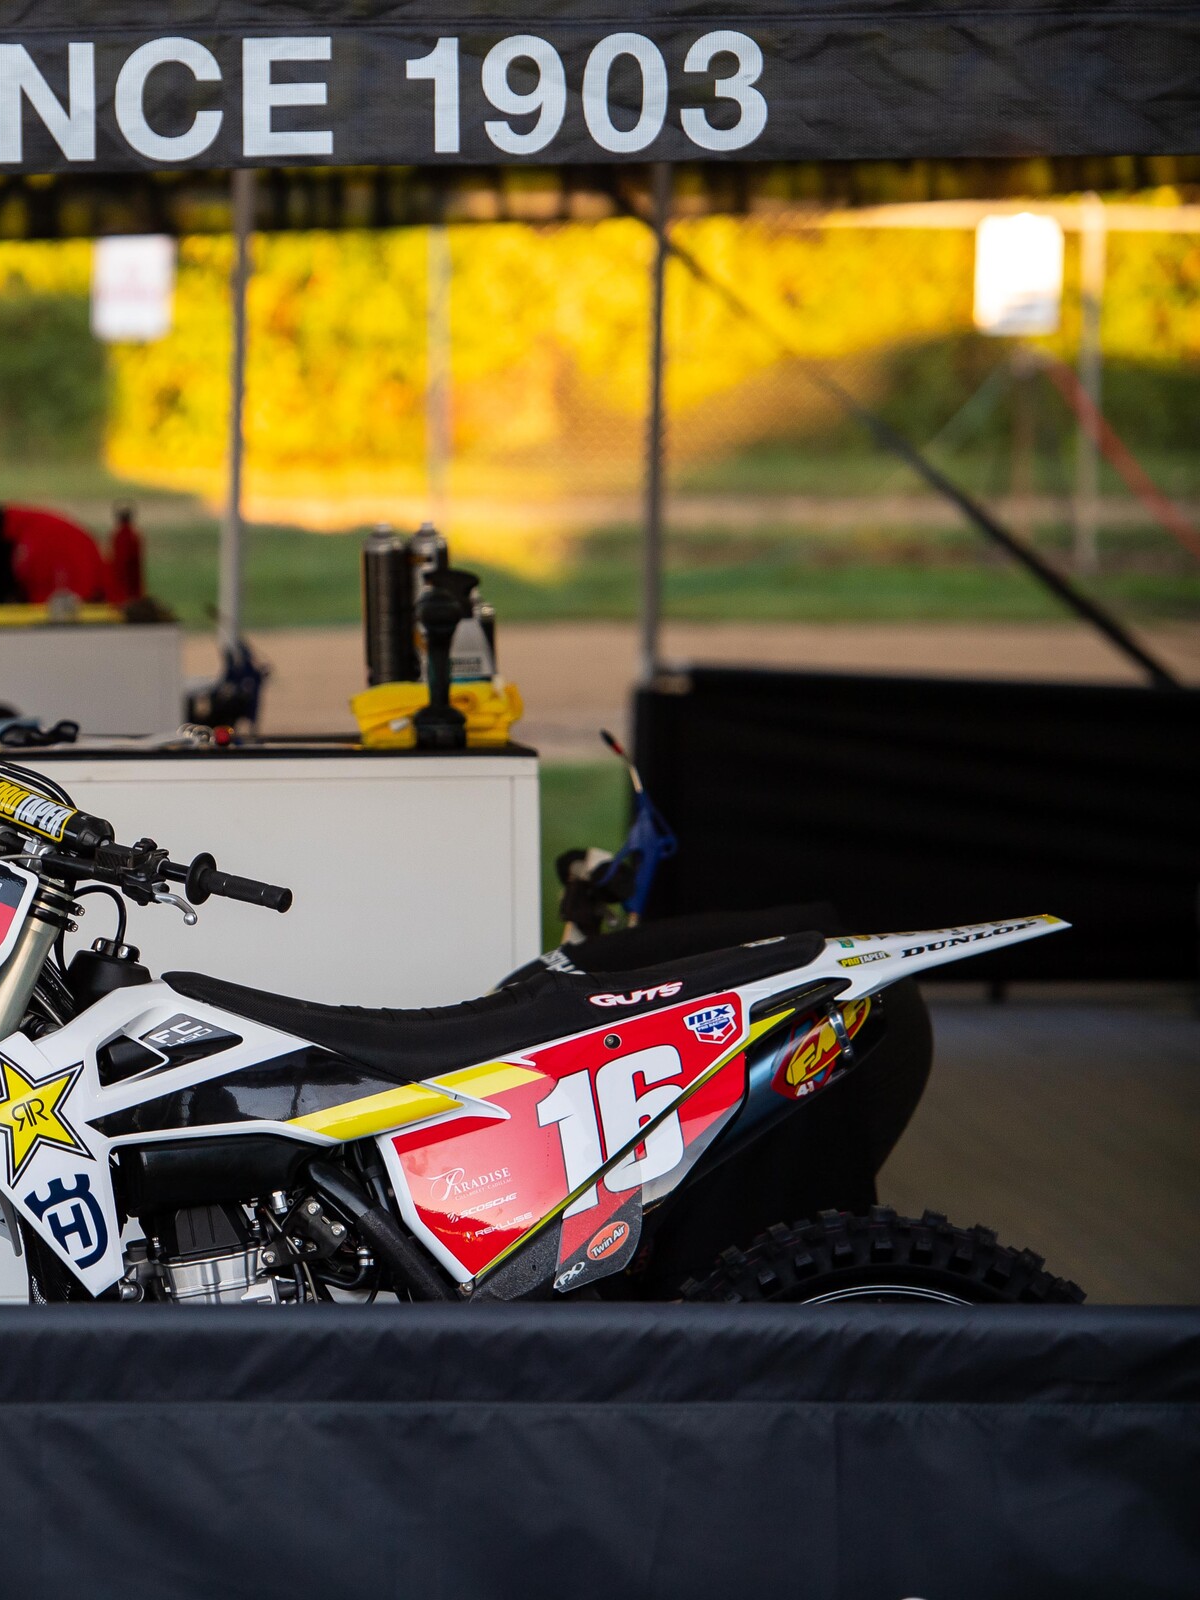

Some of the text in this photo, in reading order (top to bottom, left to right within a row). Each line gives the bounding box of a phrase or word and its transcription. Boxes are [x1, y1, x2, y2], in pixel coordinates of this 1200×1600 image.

[405, 30, 769, 155] 1903
[901, 921, 1037, 958] DUNLOP
[589, 981, 684, 1007] GUTS
[536, 1044, 685, 1220] 16
[427, 1167, 511, 1201] PARADISE
[460, 1192, 518, 1219] SCOSCHE
[475, 1211, 533, 1237] REKLUSE
[591, 1223, 626, 1258] Twin Air
